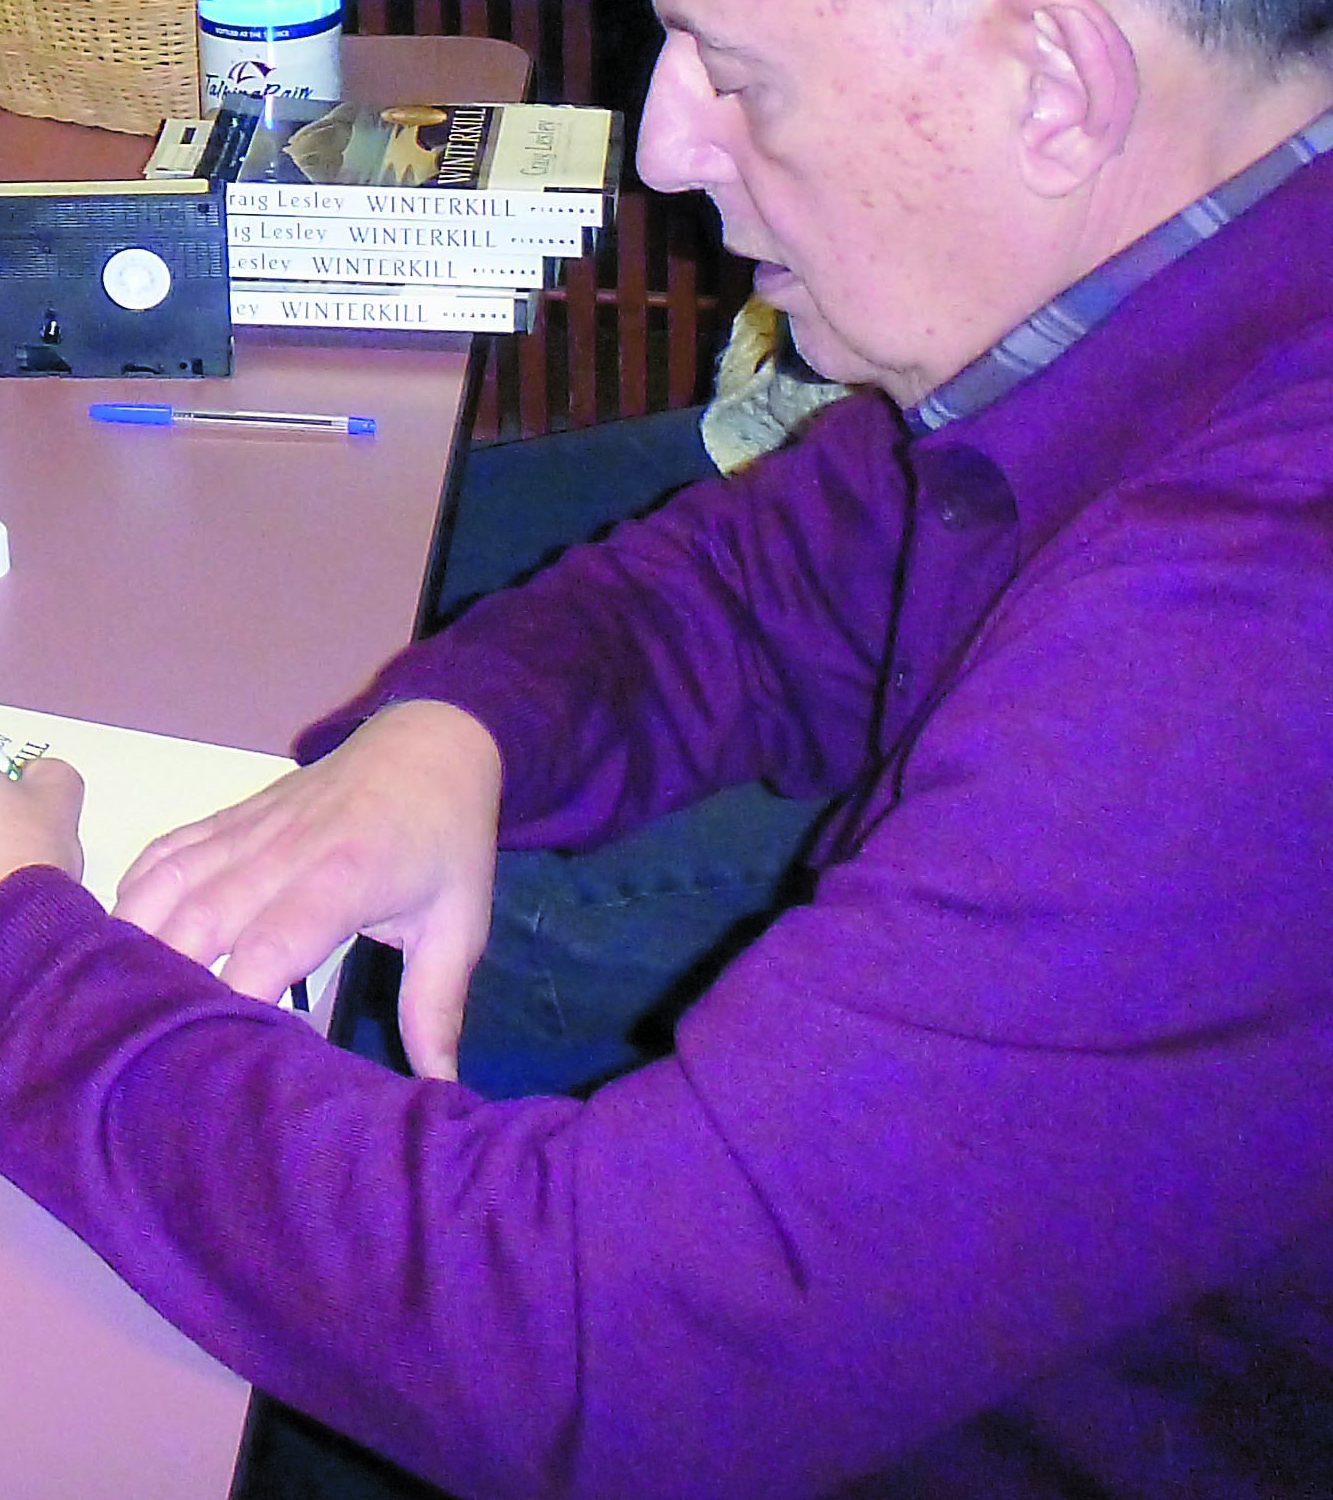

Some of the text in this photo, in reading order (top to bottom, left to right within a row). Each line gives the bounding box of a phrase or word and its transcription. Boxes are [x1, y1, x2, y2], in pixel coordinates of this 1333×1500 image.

[437, 107, 487, 185] WINTERKILL
[524, 119, 557, 151] Lesley
[229, 194, 268, 211] raig
[277, 190, 344, 210] Lesley
[366, 195, 517, 217] WINTERKILL
[260, 221, 328, 241] Lesley
[348, 226, 498, 248] WINTERKILL
[230, 253, 292, 272] esley
[312, 256, 458, 279] WINTERKILL
[281, 301, 429, 322] WINTERKILL
